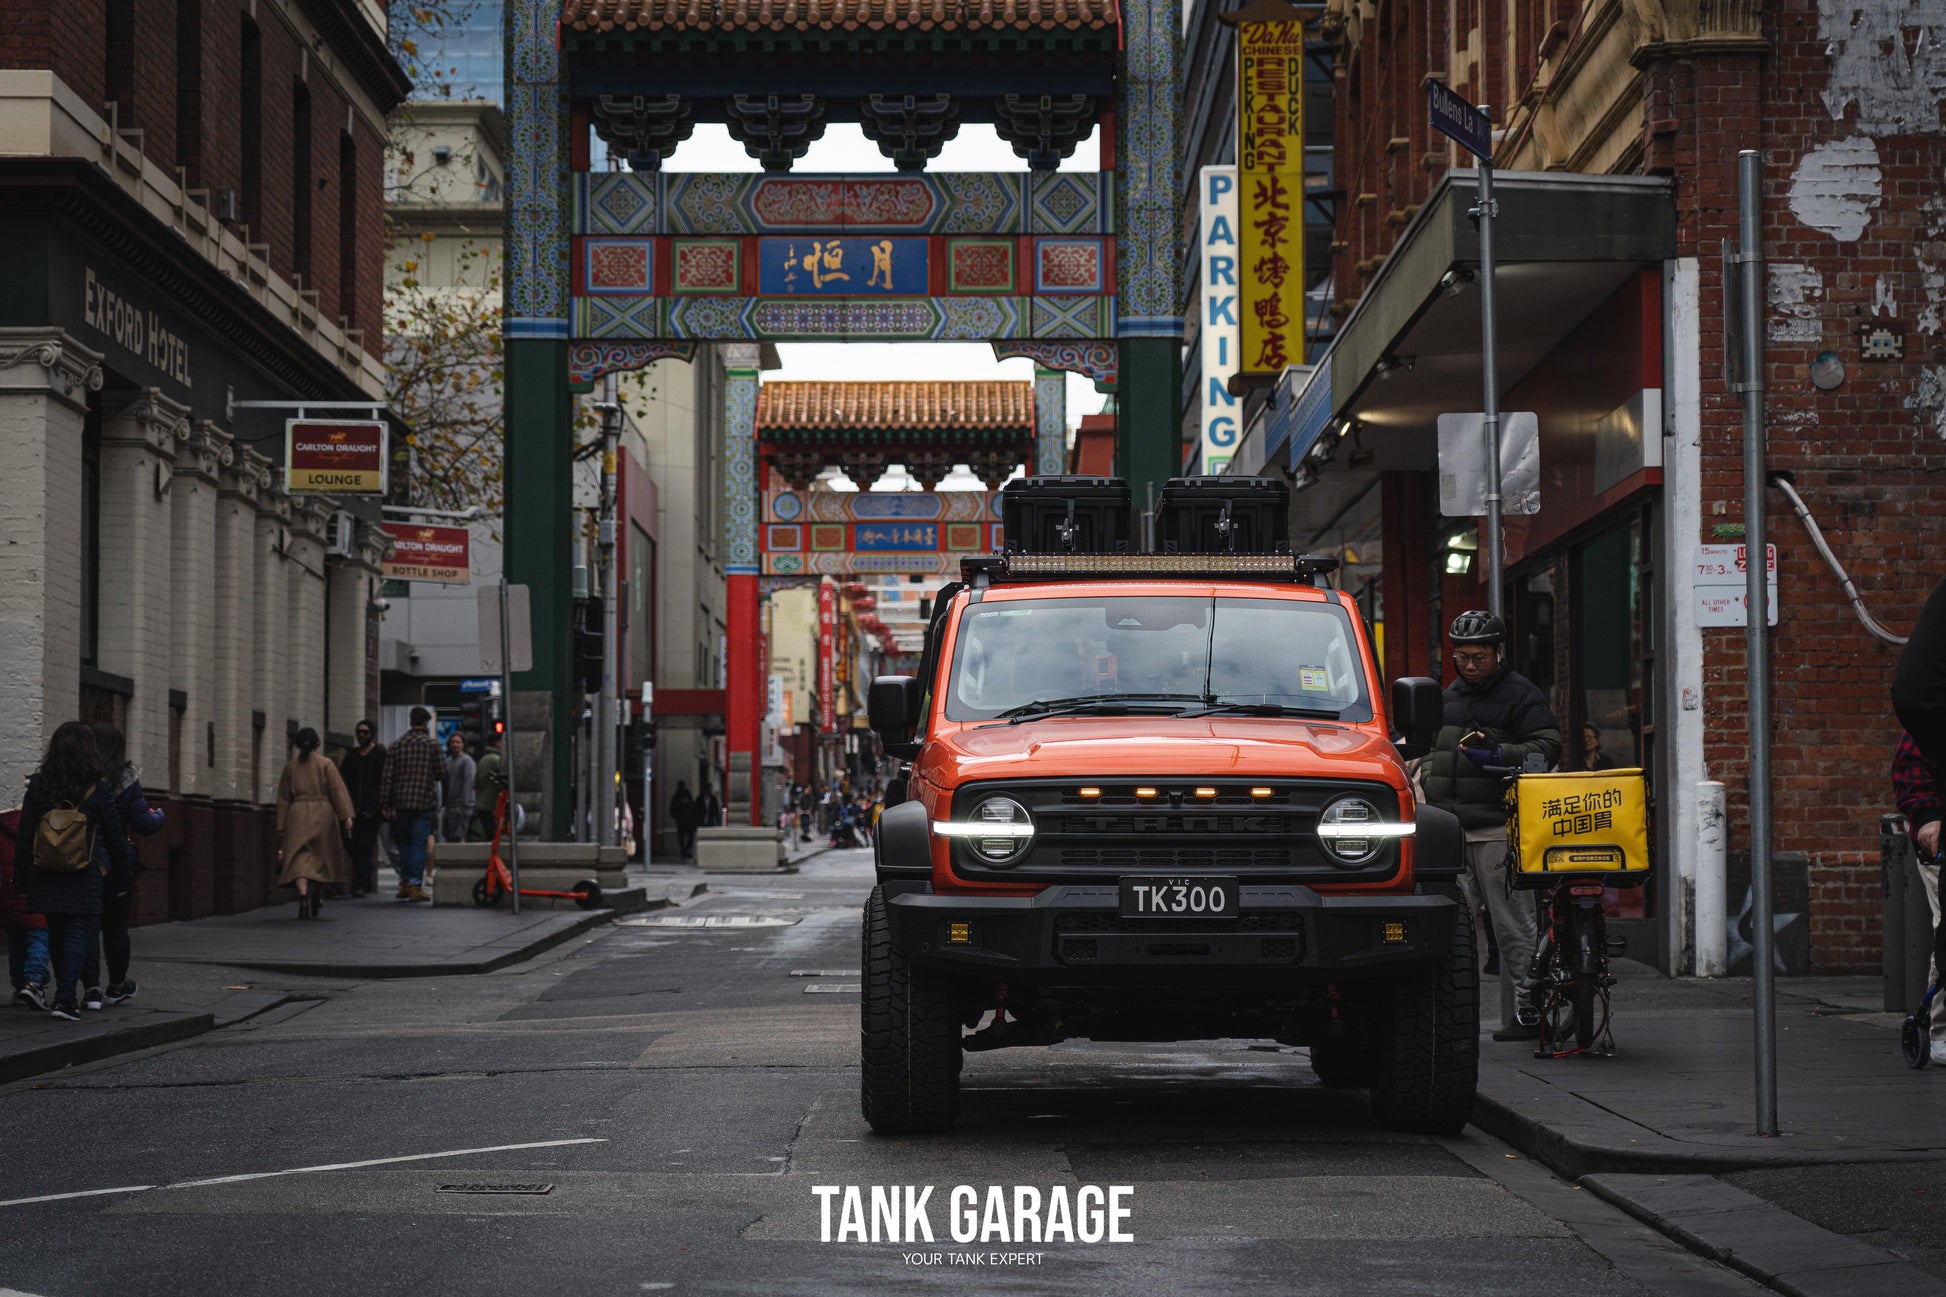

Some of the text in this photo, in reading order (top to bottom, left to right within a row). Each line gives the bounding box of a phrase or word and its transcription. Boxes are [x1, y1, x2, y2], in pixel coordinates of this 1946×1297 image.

[1243, 20, 1273, 44] Da
[1243, 46, 1300, 55] CHINESE
[1288, 58, 1299, 135] DUCK
[1433, 82, 1463, 125] Bullens
[1464, 105, 1473, 133] La
[1244, 58, 1255, 170] PEKING
[1256, 57, 1286, 172] RESTAURANT
[1207, 175, 1237, 447] PARKING
[85, 265, 191, 388] EXFORD HOTEL
[295, 442, 377, 453] CARLTON DRAUGHT
[308, 474, 361, 485] LOUNGE
[394, 540, 464, 553] ARLTON DRAUGHT
[1701, 547, 1711, 555] 15
[392, 566, 458, 578] BOTTLE SHOP
[1697, 565, 1705, 575] 7
[1718, 564, 1725, 575] 3
[1542, 788, 1622, 820] 满足你的
[1085, 816, 1267, 832] TANK
[1553, 810, 1612, 838] 中国胃
[1132, 886, 1226, 913] TK300
